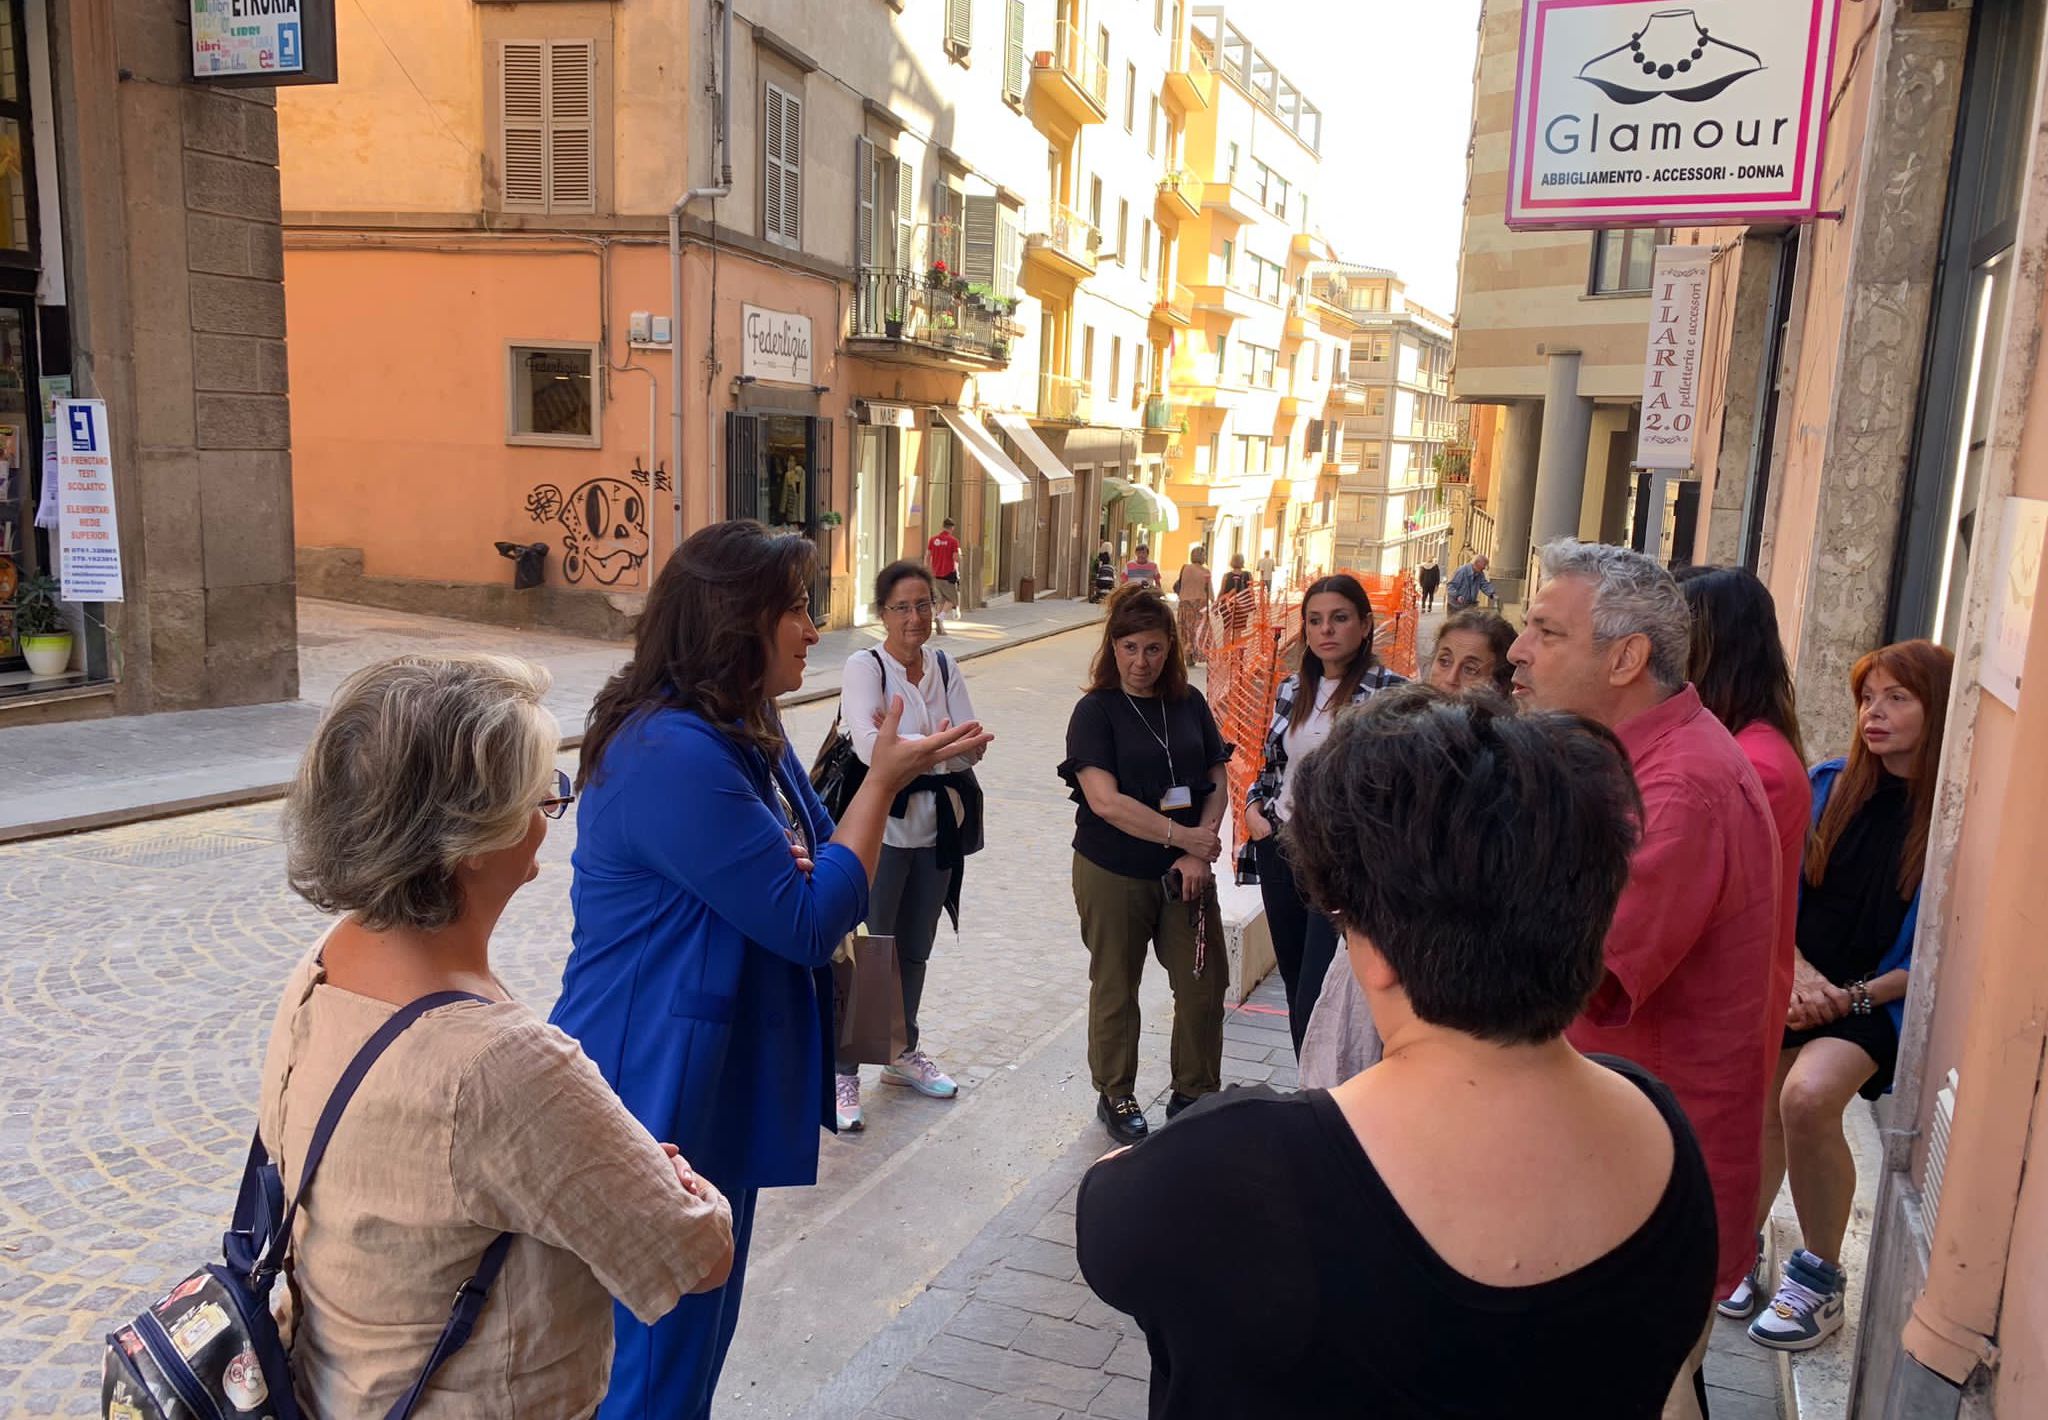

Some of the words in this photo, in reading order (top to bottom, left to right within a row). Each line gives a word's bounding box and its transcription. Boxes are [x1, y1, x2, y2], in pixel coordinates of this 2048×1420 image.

[231, 26, 260, 36] LIBRI
[196, 40, 220, 52] libri
[1544, 113, 1789, 155] Glamour
[1541, 169, 1642, 187] ABBIGLIAMENTO
[1653, 166, 1727, 183] ACCESSORI
[1737, 164, 1785, 180] DONNA
[747, 312, 809, 378] Federlizia
[1647, 283, 1680, 410] ILARIA
[1679, 349, 1696, 408] pelletteria
[1688, 283, 1703, 336] accessori
[1645, 413, 1692, 432] 2.0
[78, 469, 97, 478] TESTI
[67, 482, 107, 491] SCOLASTICI
[66, 505, 110, 514] ELEMENTARI
[79, 518, 101, 527] MEDIE
[71, 531, 109, 540] SUPERIORI
